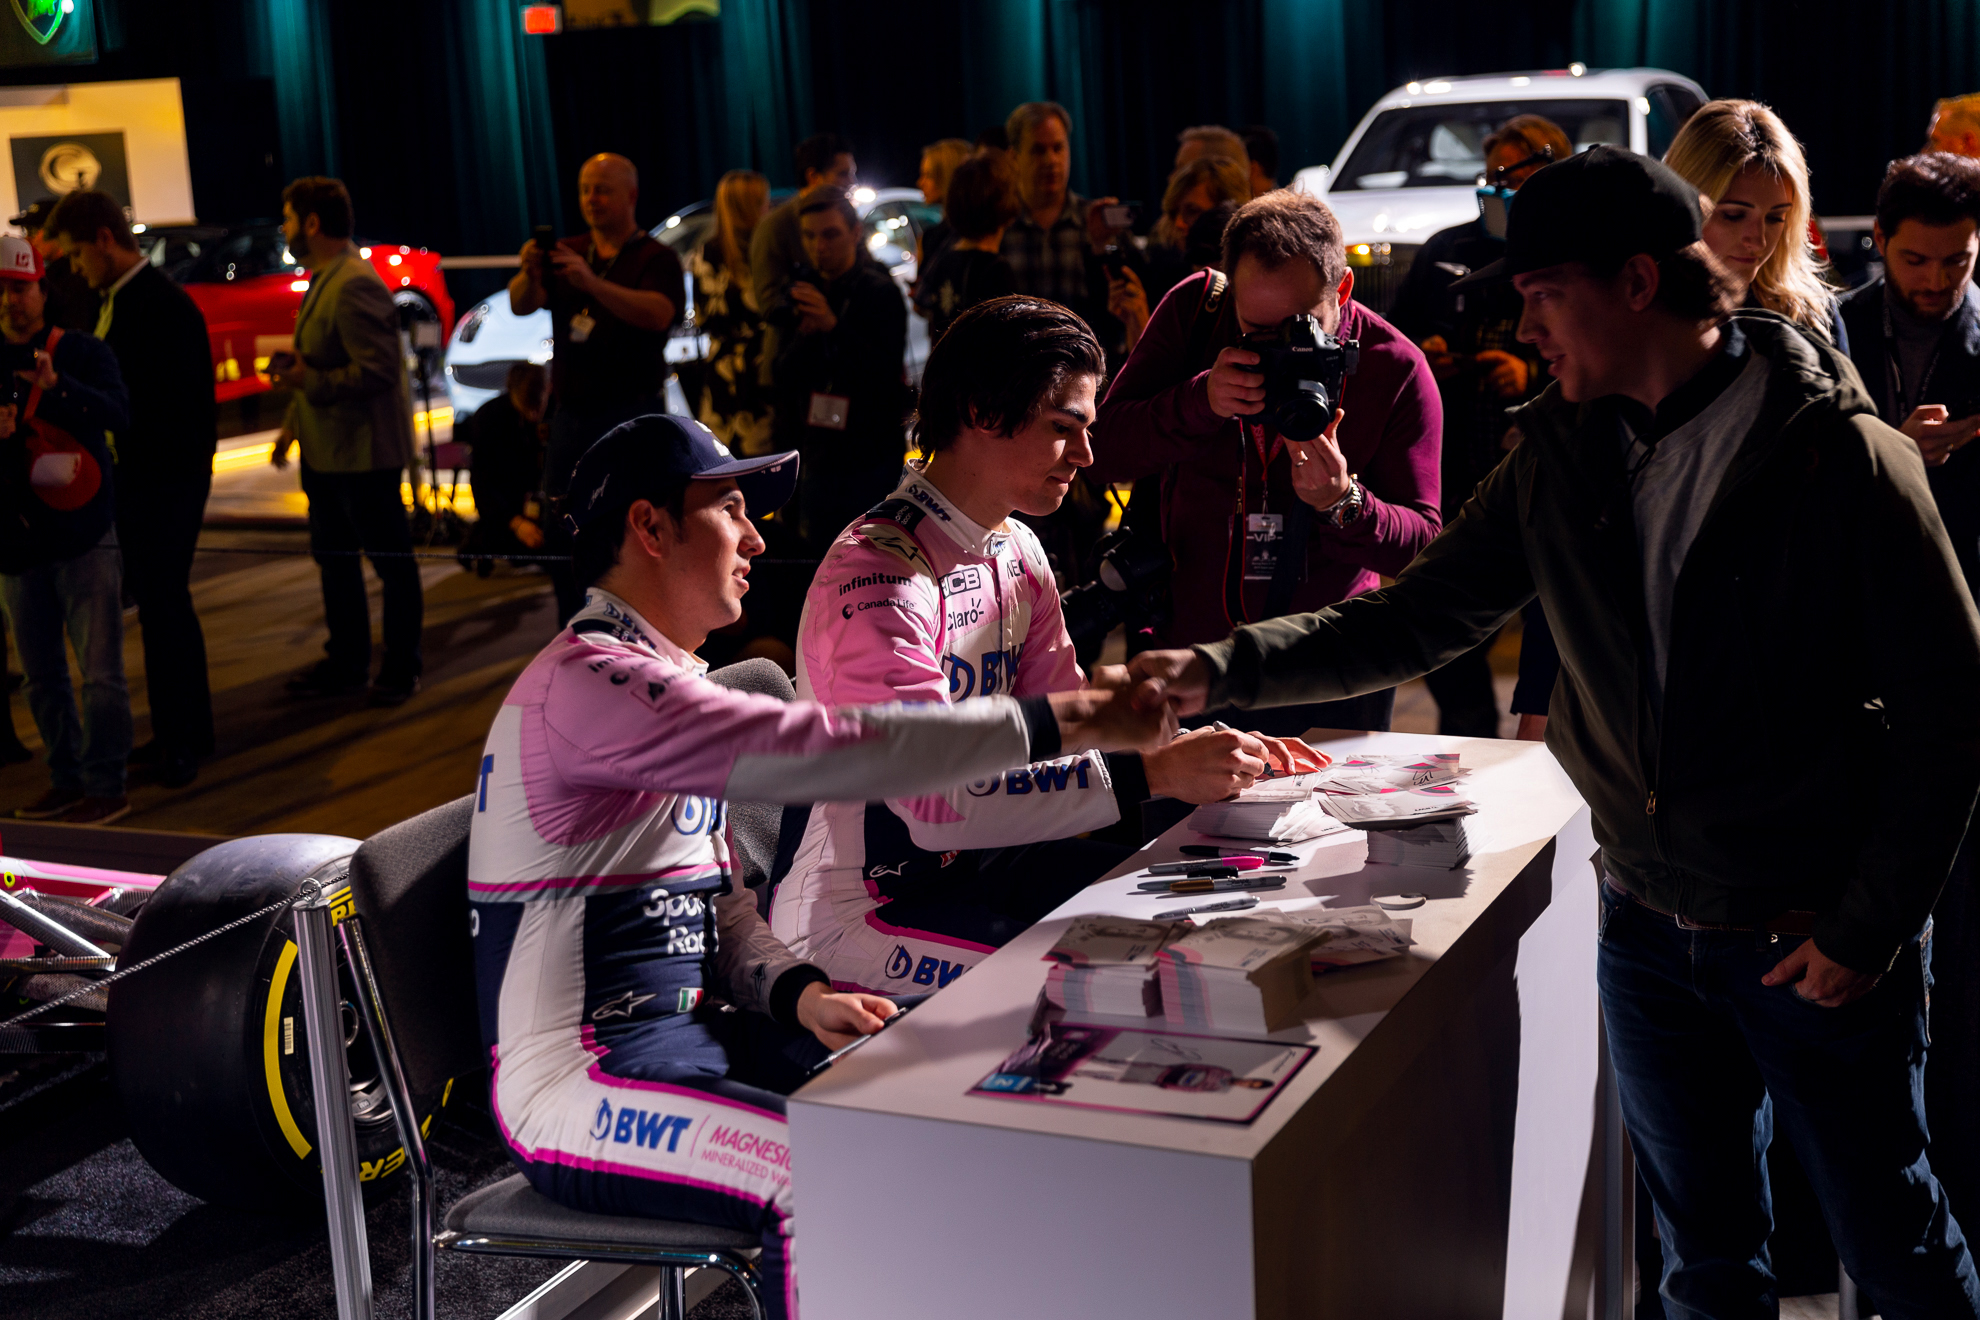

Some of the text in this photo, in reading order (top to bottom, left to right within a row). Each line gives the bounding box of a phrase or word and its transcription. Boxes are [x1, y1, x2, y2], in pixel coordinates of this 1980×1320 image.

[1253, 532, 1277, 543] VIP
[839, 573, 912, 596] infinitum
[857, 598, 914, 611] Canada Life
[1006, 759, 1091, 795] BWT
[912, 955, 973, 989] BW
[613, 1107, 693, 1153] BWT
[701, 1148, 769, 1179] MINERALIZED
